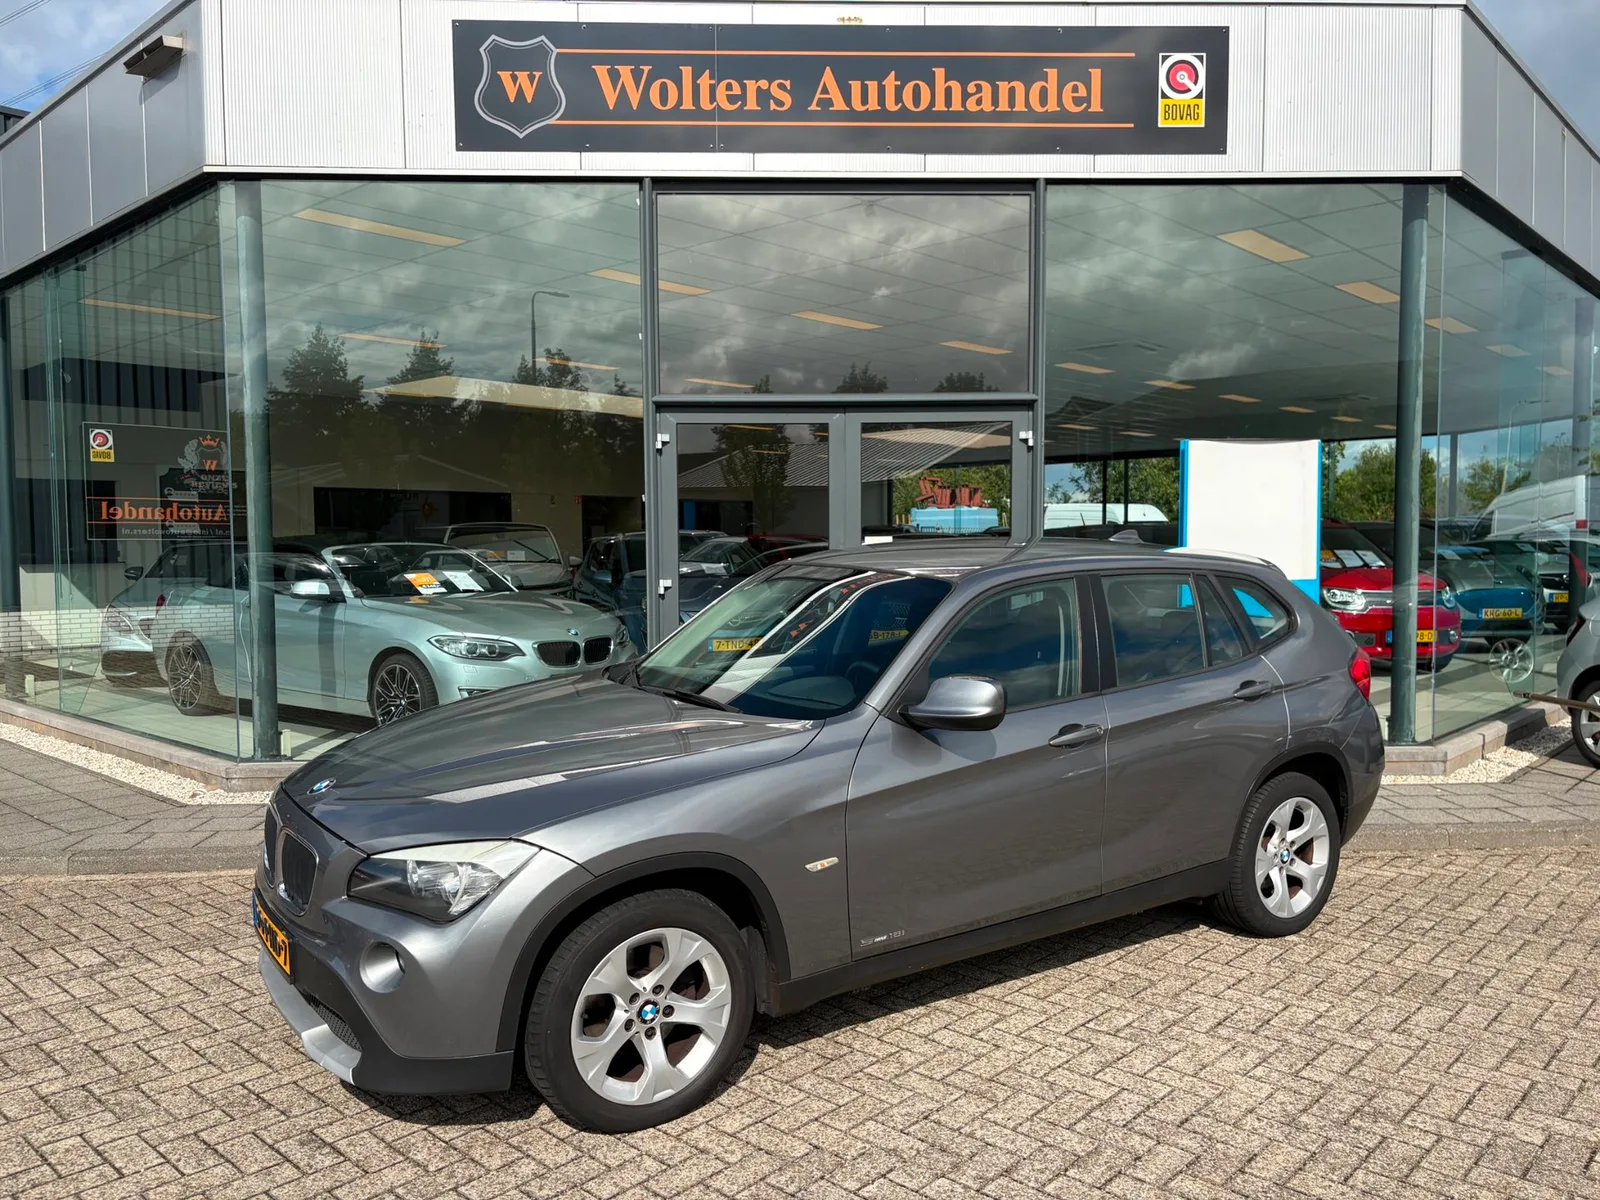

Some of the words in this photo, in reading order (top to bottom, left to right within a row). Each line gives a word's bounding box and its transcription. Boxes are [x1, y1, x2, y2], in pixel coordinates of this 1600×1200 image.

[497, 70, 543, 103] W
[592, 64, 793, 114] Wolters
[807, 66, 1104, 115] Autohandel
[1164, 103, 1200, 121] BOVAG
